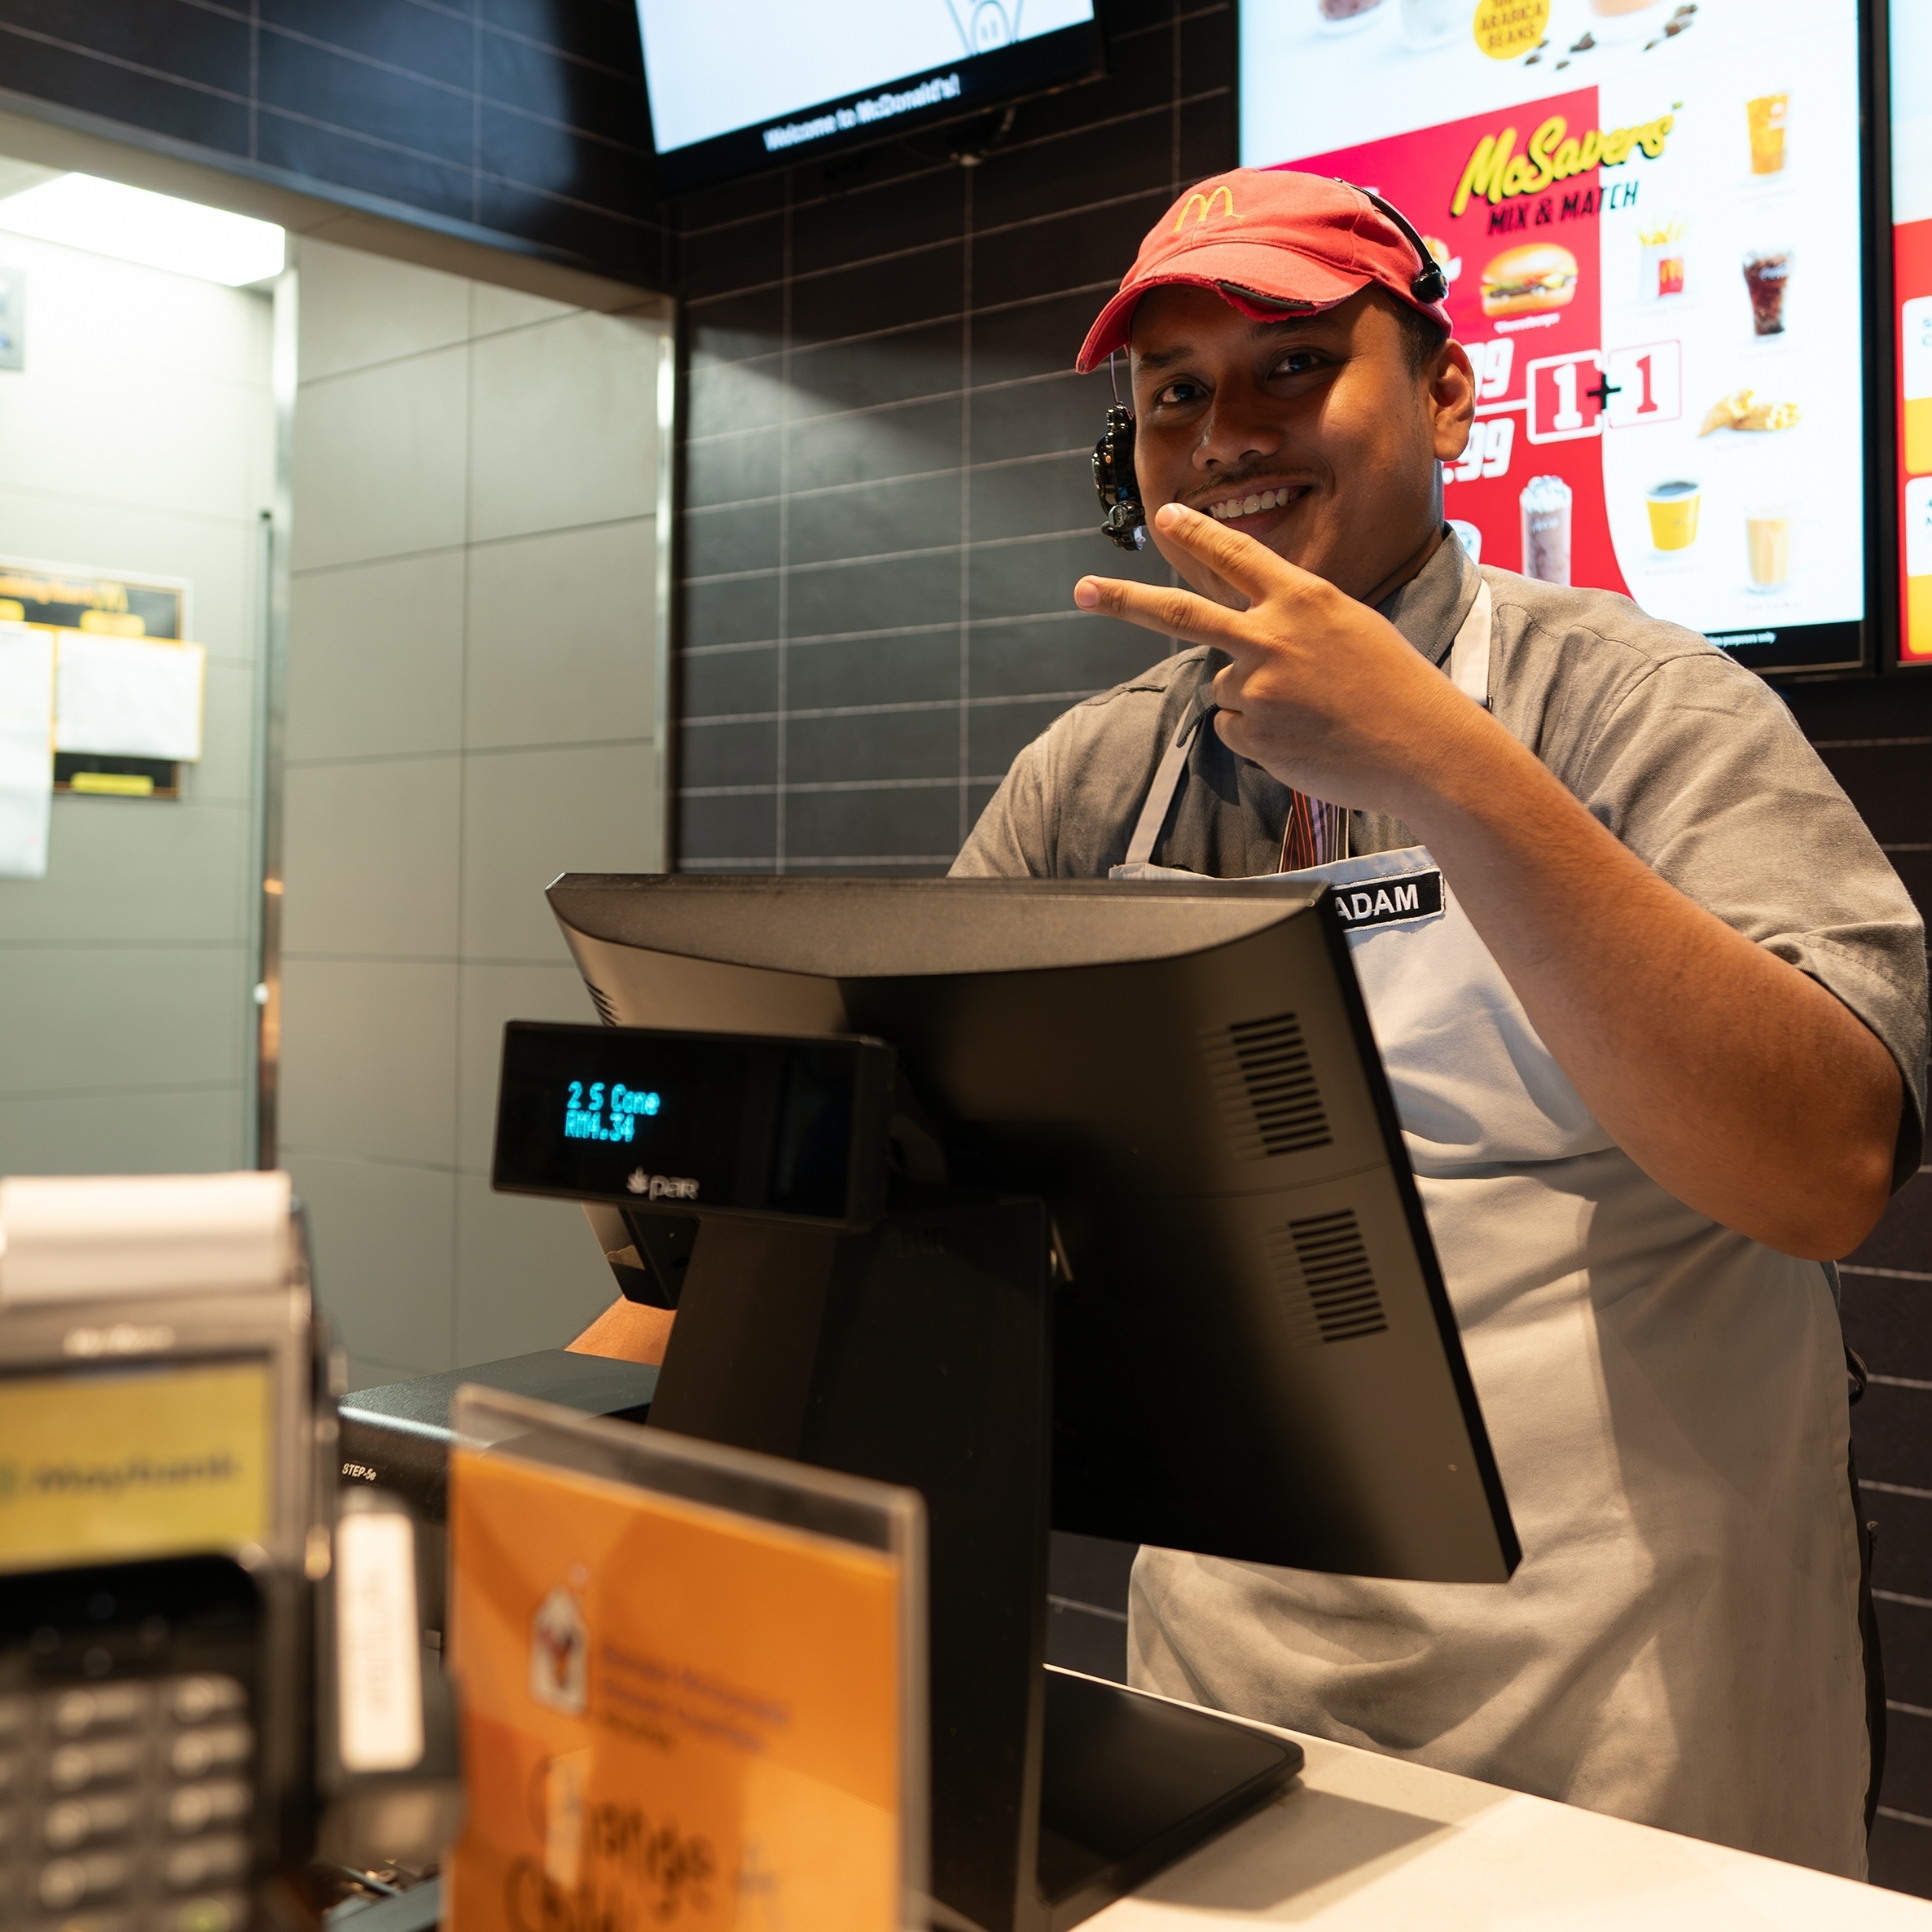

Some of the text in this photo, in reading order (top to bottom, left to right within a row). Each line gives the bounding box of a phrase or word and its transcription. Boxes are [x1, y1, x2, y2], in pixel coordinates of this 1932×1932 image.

[762, 72, 961, 153] Welcome to McDonald's!
[1487, 180, 1640, 236] MIX & MATCH
[1552, 362, 1583, 431] 1
[1636, 353, 1658, 414] 1
[1758, 631, 1776, 645] only
[1334, 884, 1420, 921] ADAM
[568, 1081, 582, 1109] 2
[611, 1083, 661, 1116] Cone
[564, 1109, 635, 1143] RM4.34
[341, 1462, 377, 1482] STEP-5e
